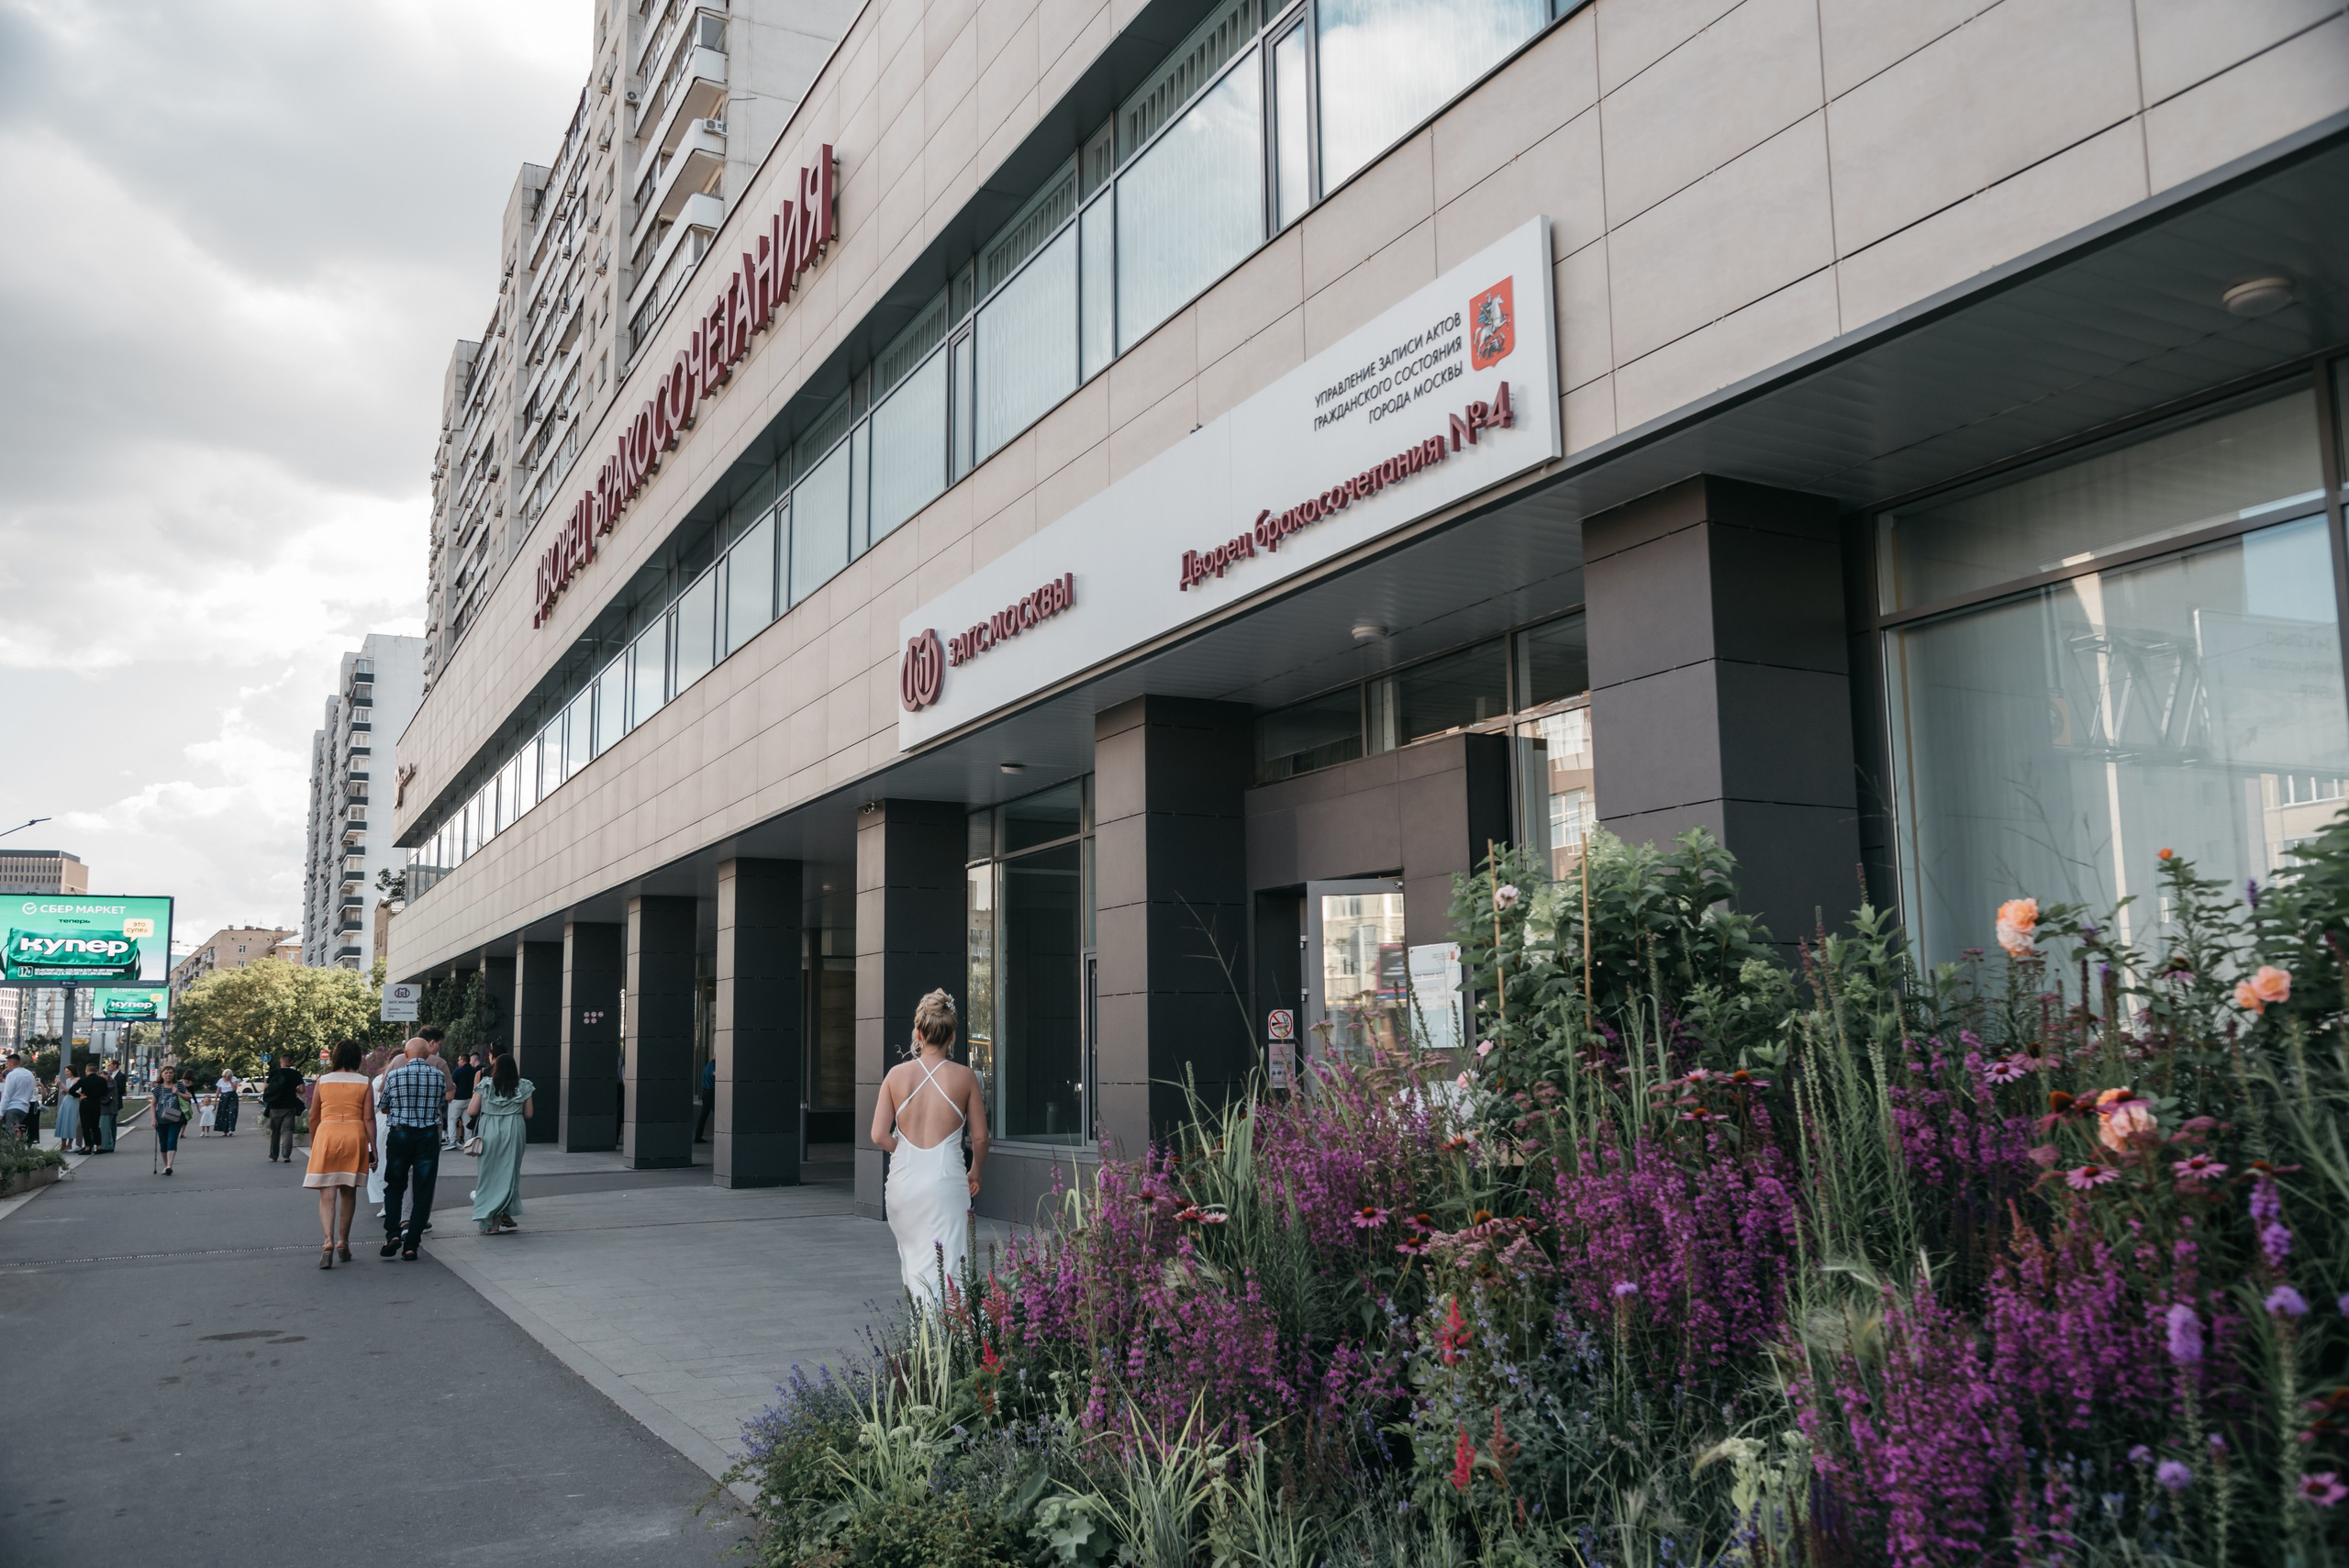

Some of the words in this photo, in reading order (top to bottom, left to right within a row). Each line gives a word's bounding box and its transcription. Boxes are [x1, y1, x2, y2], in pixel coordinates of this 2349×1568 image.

[533, 490, 593, 629] ДВОРЕЦ
[596, 144, 832, 538] БРАКОСОЧЕТАНИЯ
[1314, 377, 1392, 431] ГРАЖДАНСКОГО
[1394, 336, 1462, 385] СОСТОЯНИЯ
[1315, 361, 1376, 408] УПРАВЛЕНИЕ
[1378, 334, 1423, 372] ЗАПИСИ
[1425, 312, 1462, 345] АКТОВ
[1369, 391, 1411, 424] ГОРОДА
[1413, 361, 1463, 401] МОСКВЫ
[1180, 532, 1254, 592] Дворец
[1253, 435, 1445, 552] бракосочетания
[948, 622, 988, 667] ЗАГС
[988, 573, 1074, 646] МОСКВЫ
[19, 937, 129, 957] купер
[39, 905, 73, 914] СБЕР
[75, 906, 127, 915] МАРКЕТ
[110, 1001, 153, 1009] купер
